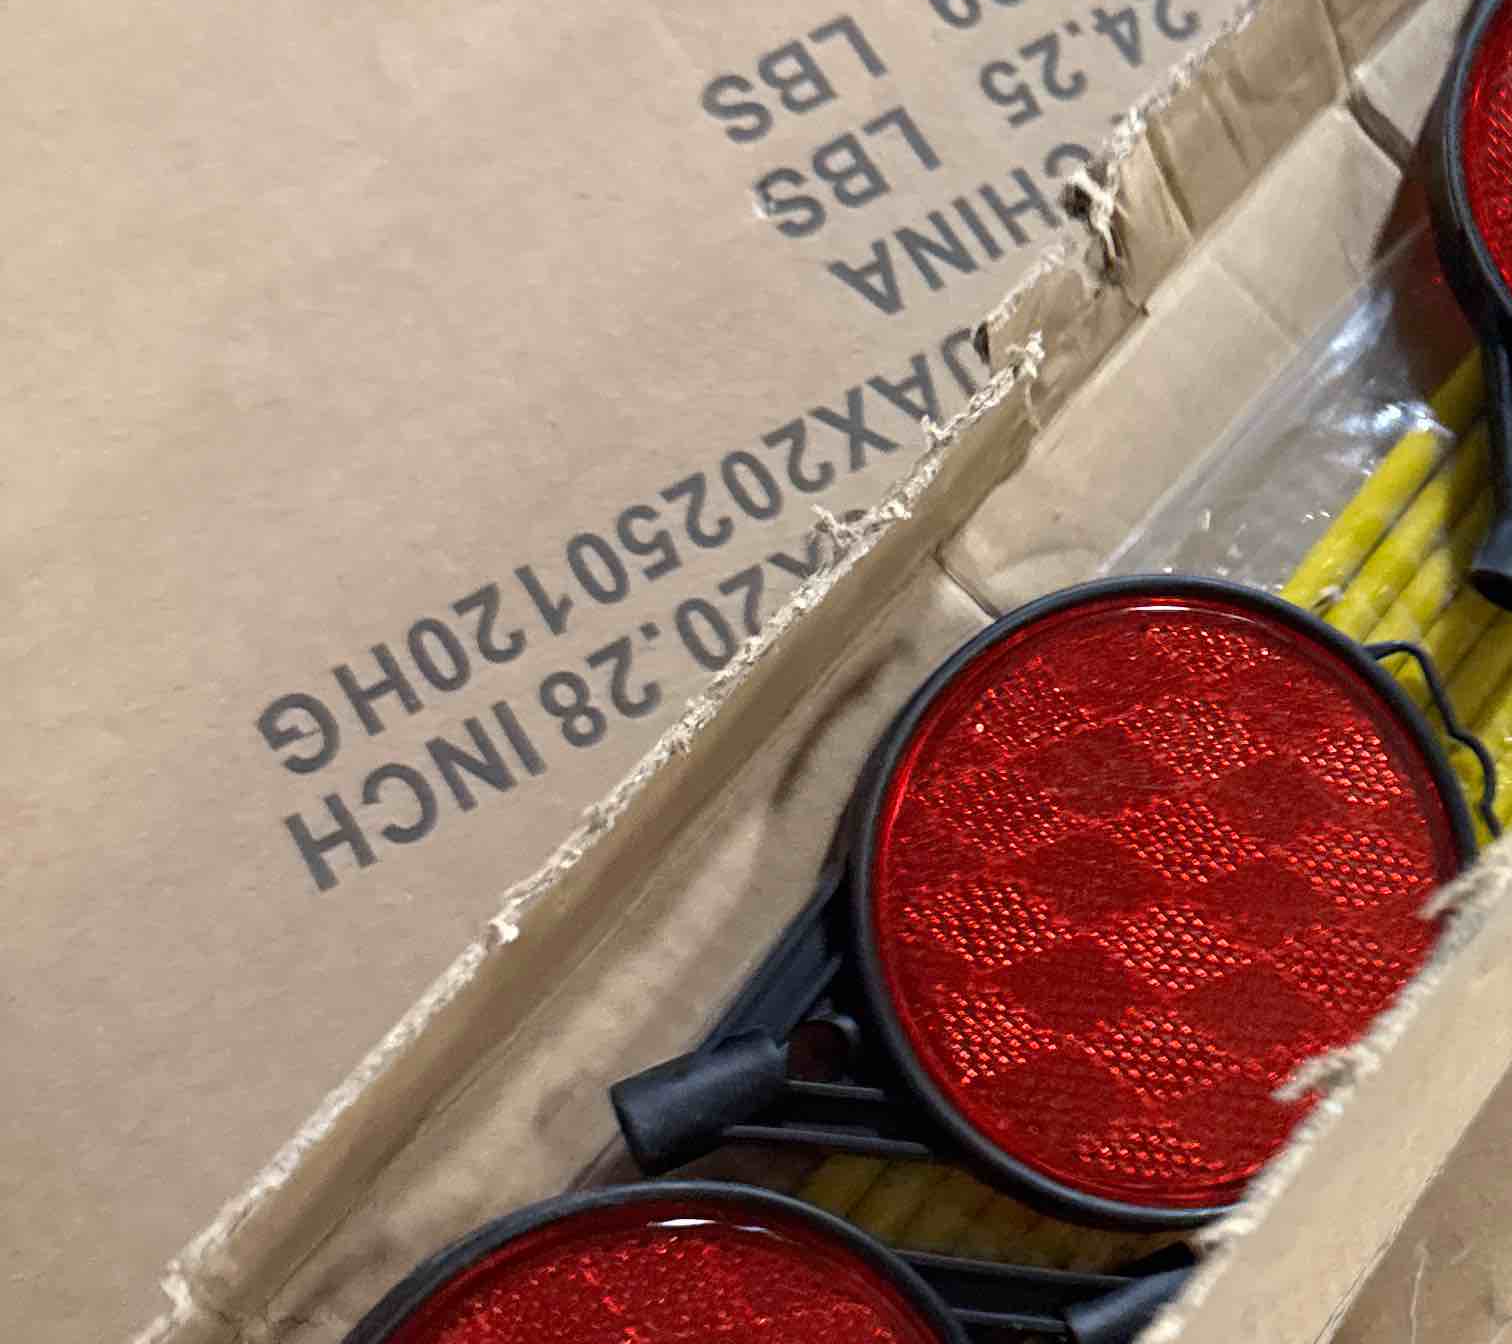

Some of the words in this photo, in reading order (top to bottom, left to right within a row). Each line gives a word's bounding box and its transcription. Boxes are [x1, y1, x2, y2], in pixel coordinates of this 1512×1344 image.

[701, 15, 888, 144] LBS
[753, 104, 942, 238] LBS
[284, 701, 547, 892] INCH
